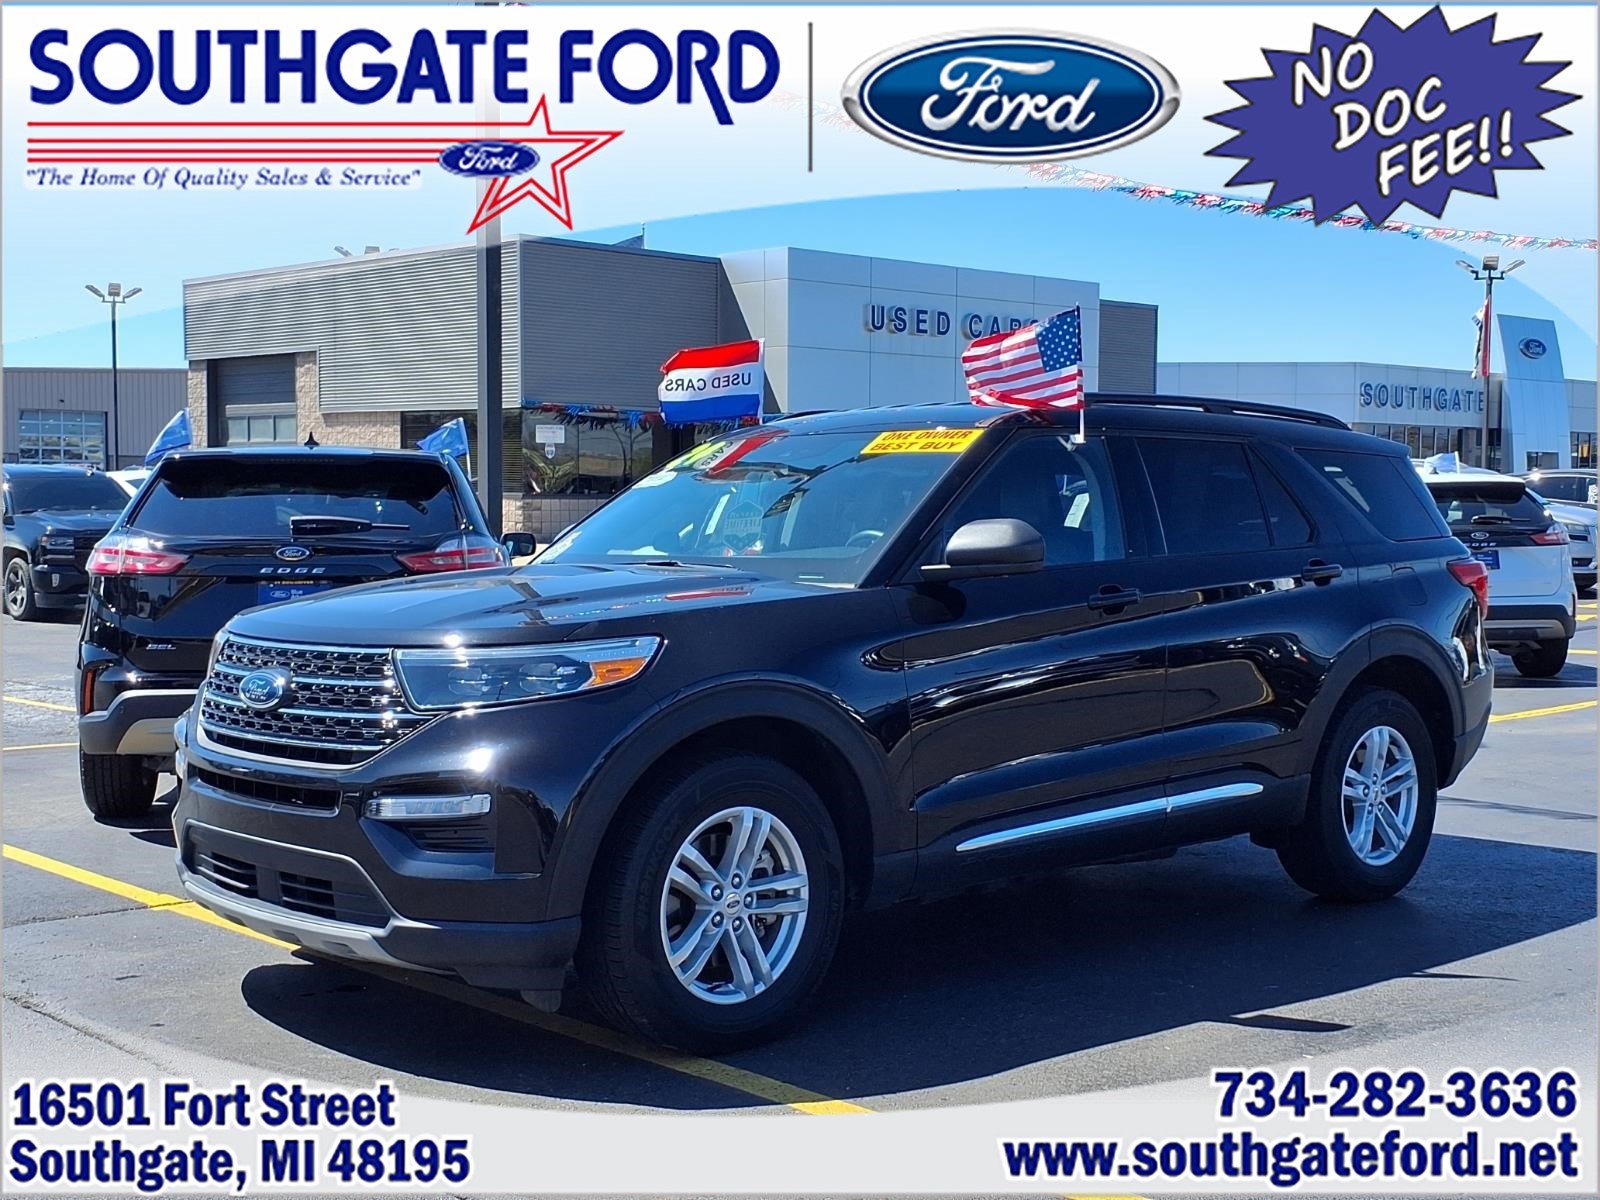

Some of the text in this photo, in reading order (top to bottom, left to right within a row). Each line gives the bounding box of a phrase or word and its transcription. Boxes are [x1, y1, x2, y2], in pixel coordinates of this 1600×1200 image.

[871, 304, 950, 336] USED
[1361, 381, 1485, 412] SOUTHGATE
[870, 441, 961, 451] BEST BUY
[882, 430, 973, 441] ONE OWNER
